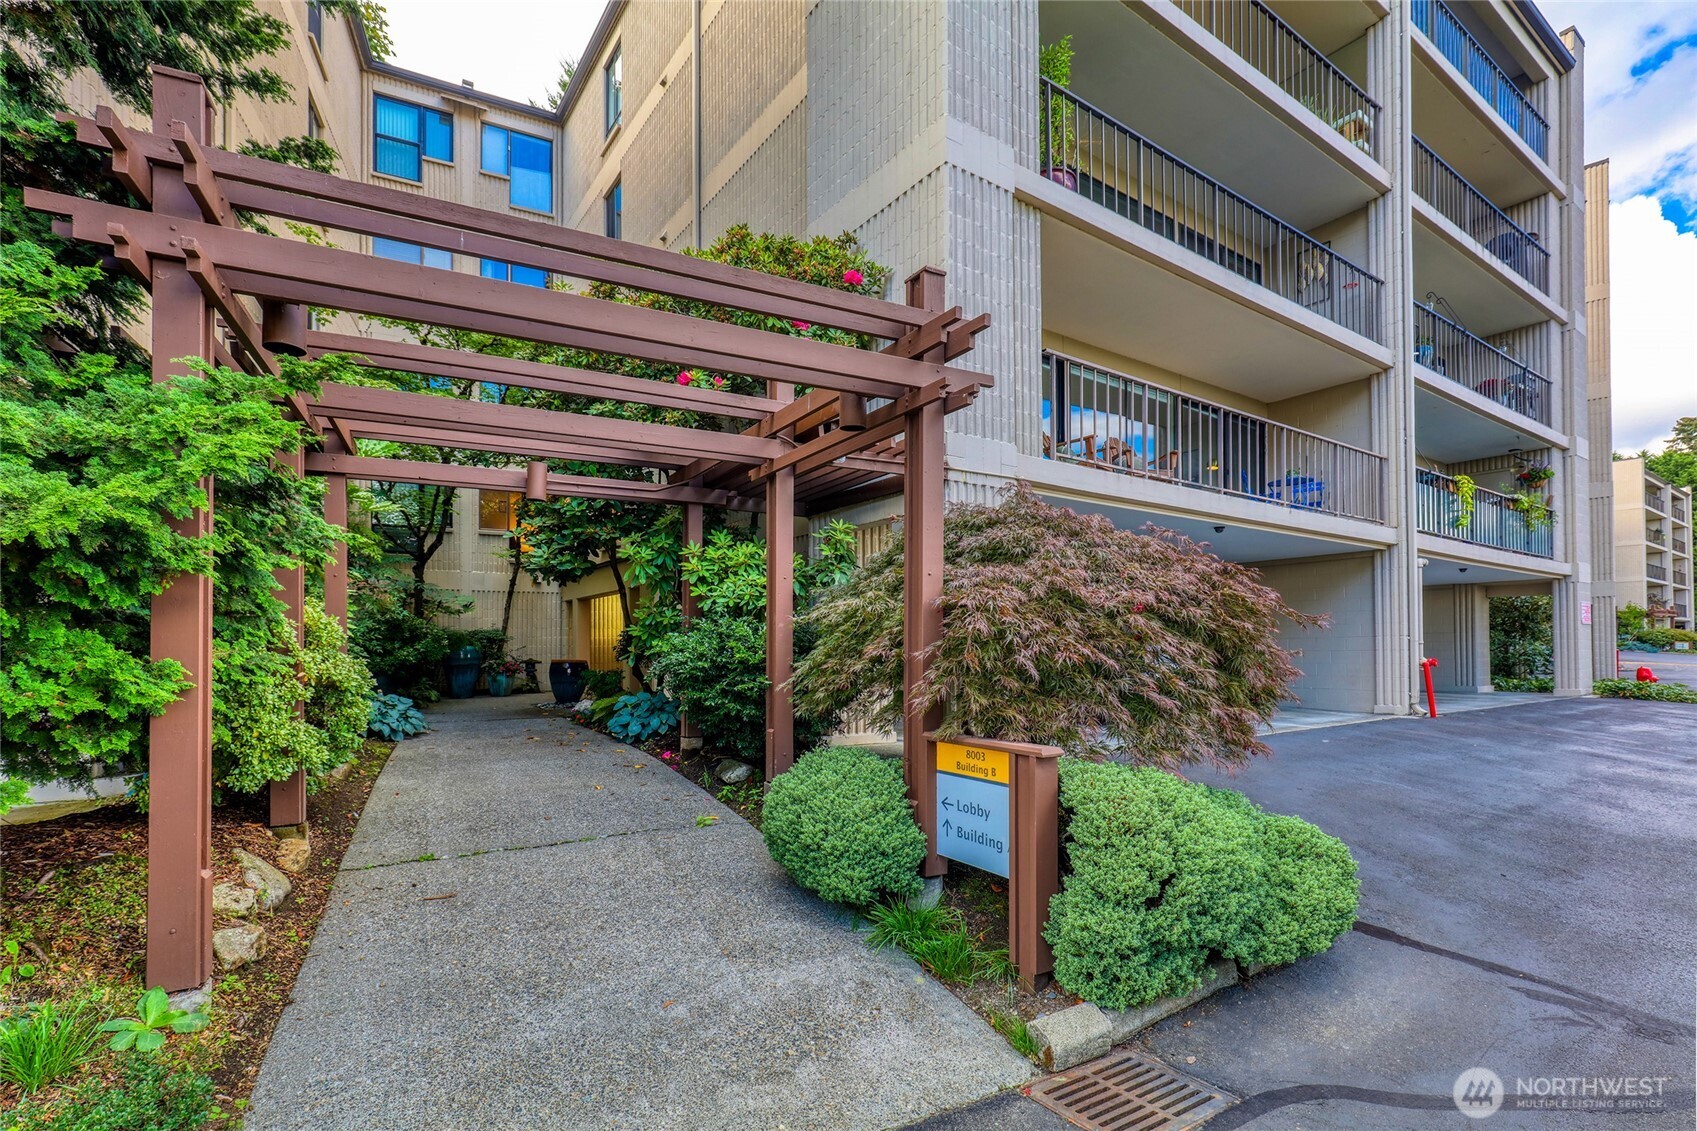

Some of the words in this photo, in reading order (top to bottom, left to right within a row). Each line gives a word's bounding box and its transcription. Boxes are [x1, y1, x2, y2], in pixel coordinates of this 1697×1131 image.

[965, 750, 986, 762] 8003
[956, 761, 989, 777] Building
[991, 768, 997, 777] B
[957, 800, 991, 822] Lobby
[957, 826, 1003, 854] Building
